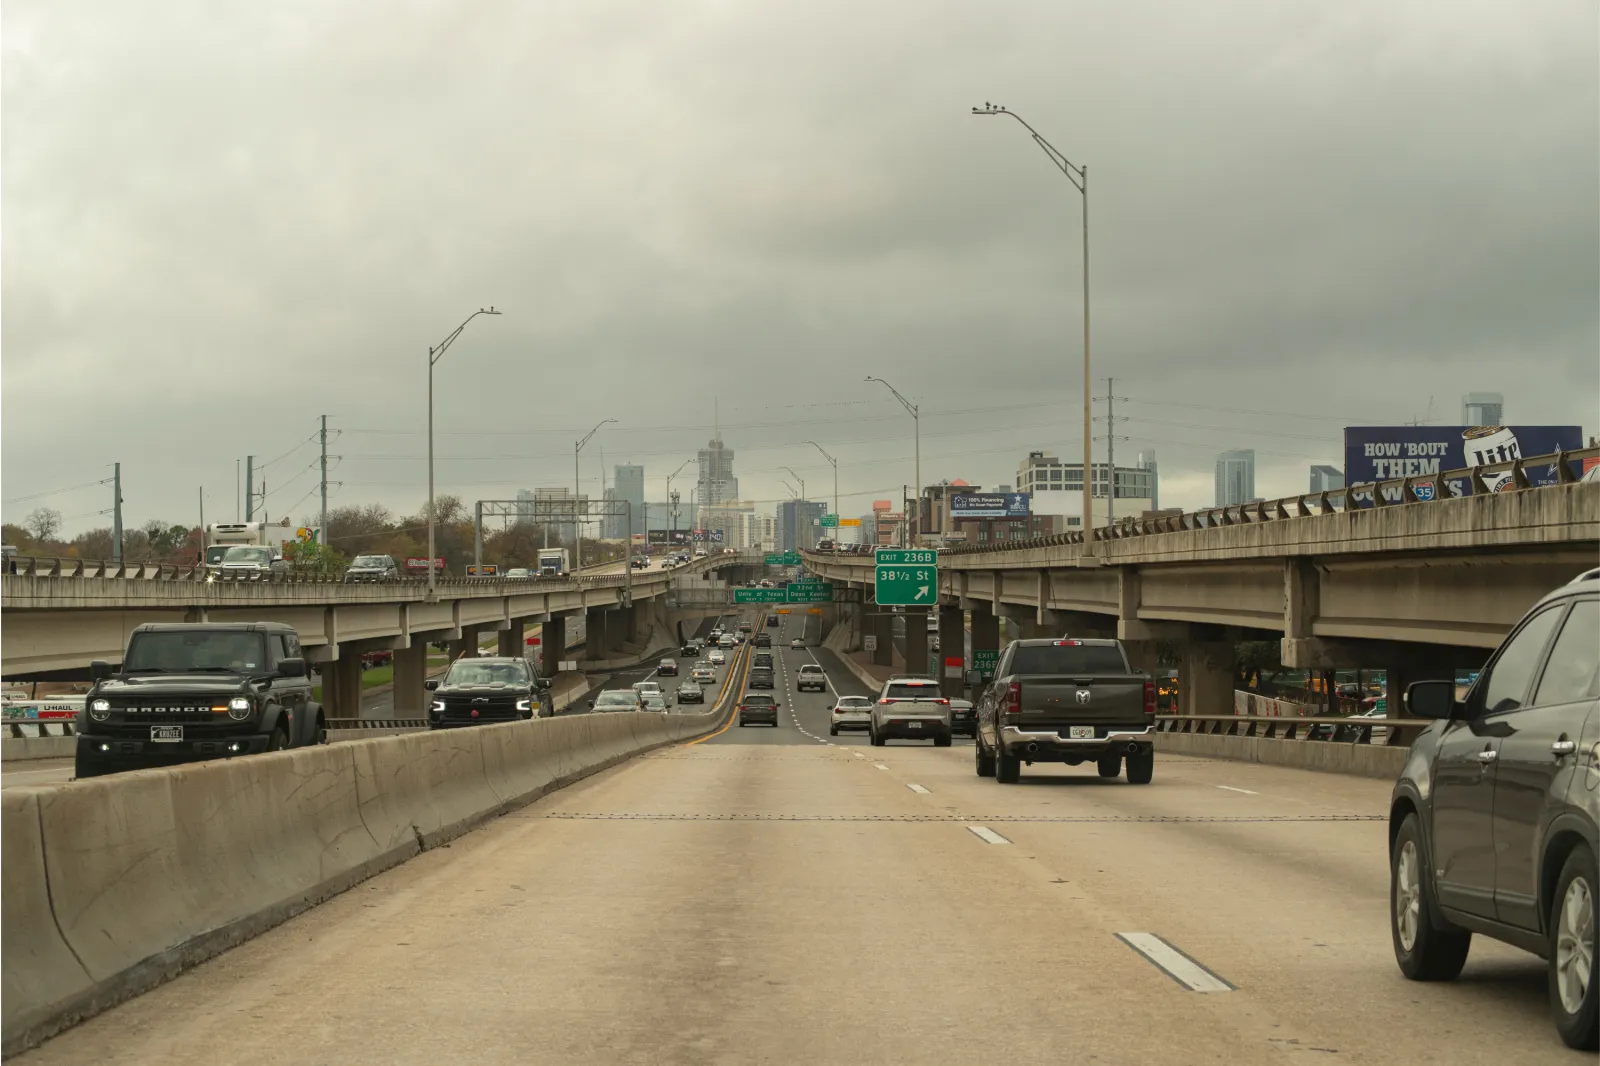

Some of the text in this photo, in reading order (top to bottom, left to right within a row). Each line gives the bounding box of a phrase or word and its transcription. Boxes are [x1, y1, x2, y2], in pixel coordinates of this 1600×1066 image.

[1364, 442, 1448, 456] HOW 'BOUT
[1373, 458, 1440, 478] THEM
[1417, 488, 1432, 497] 35
[904, 552, 932, 562] 236B
[916, 570, 929, 581] St
[159, 729, 180, 738] KRUZEE
